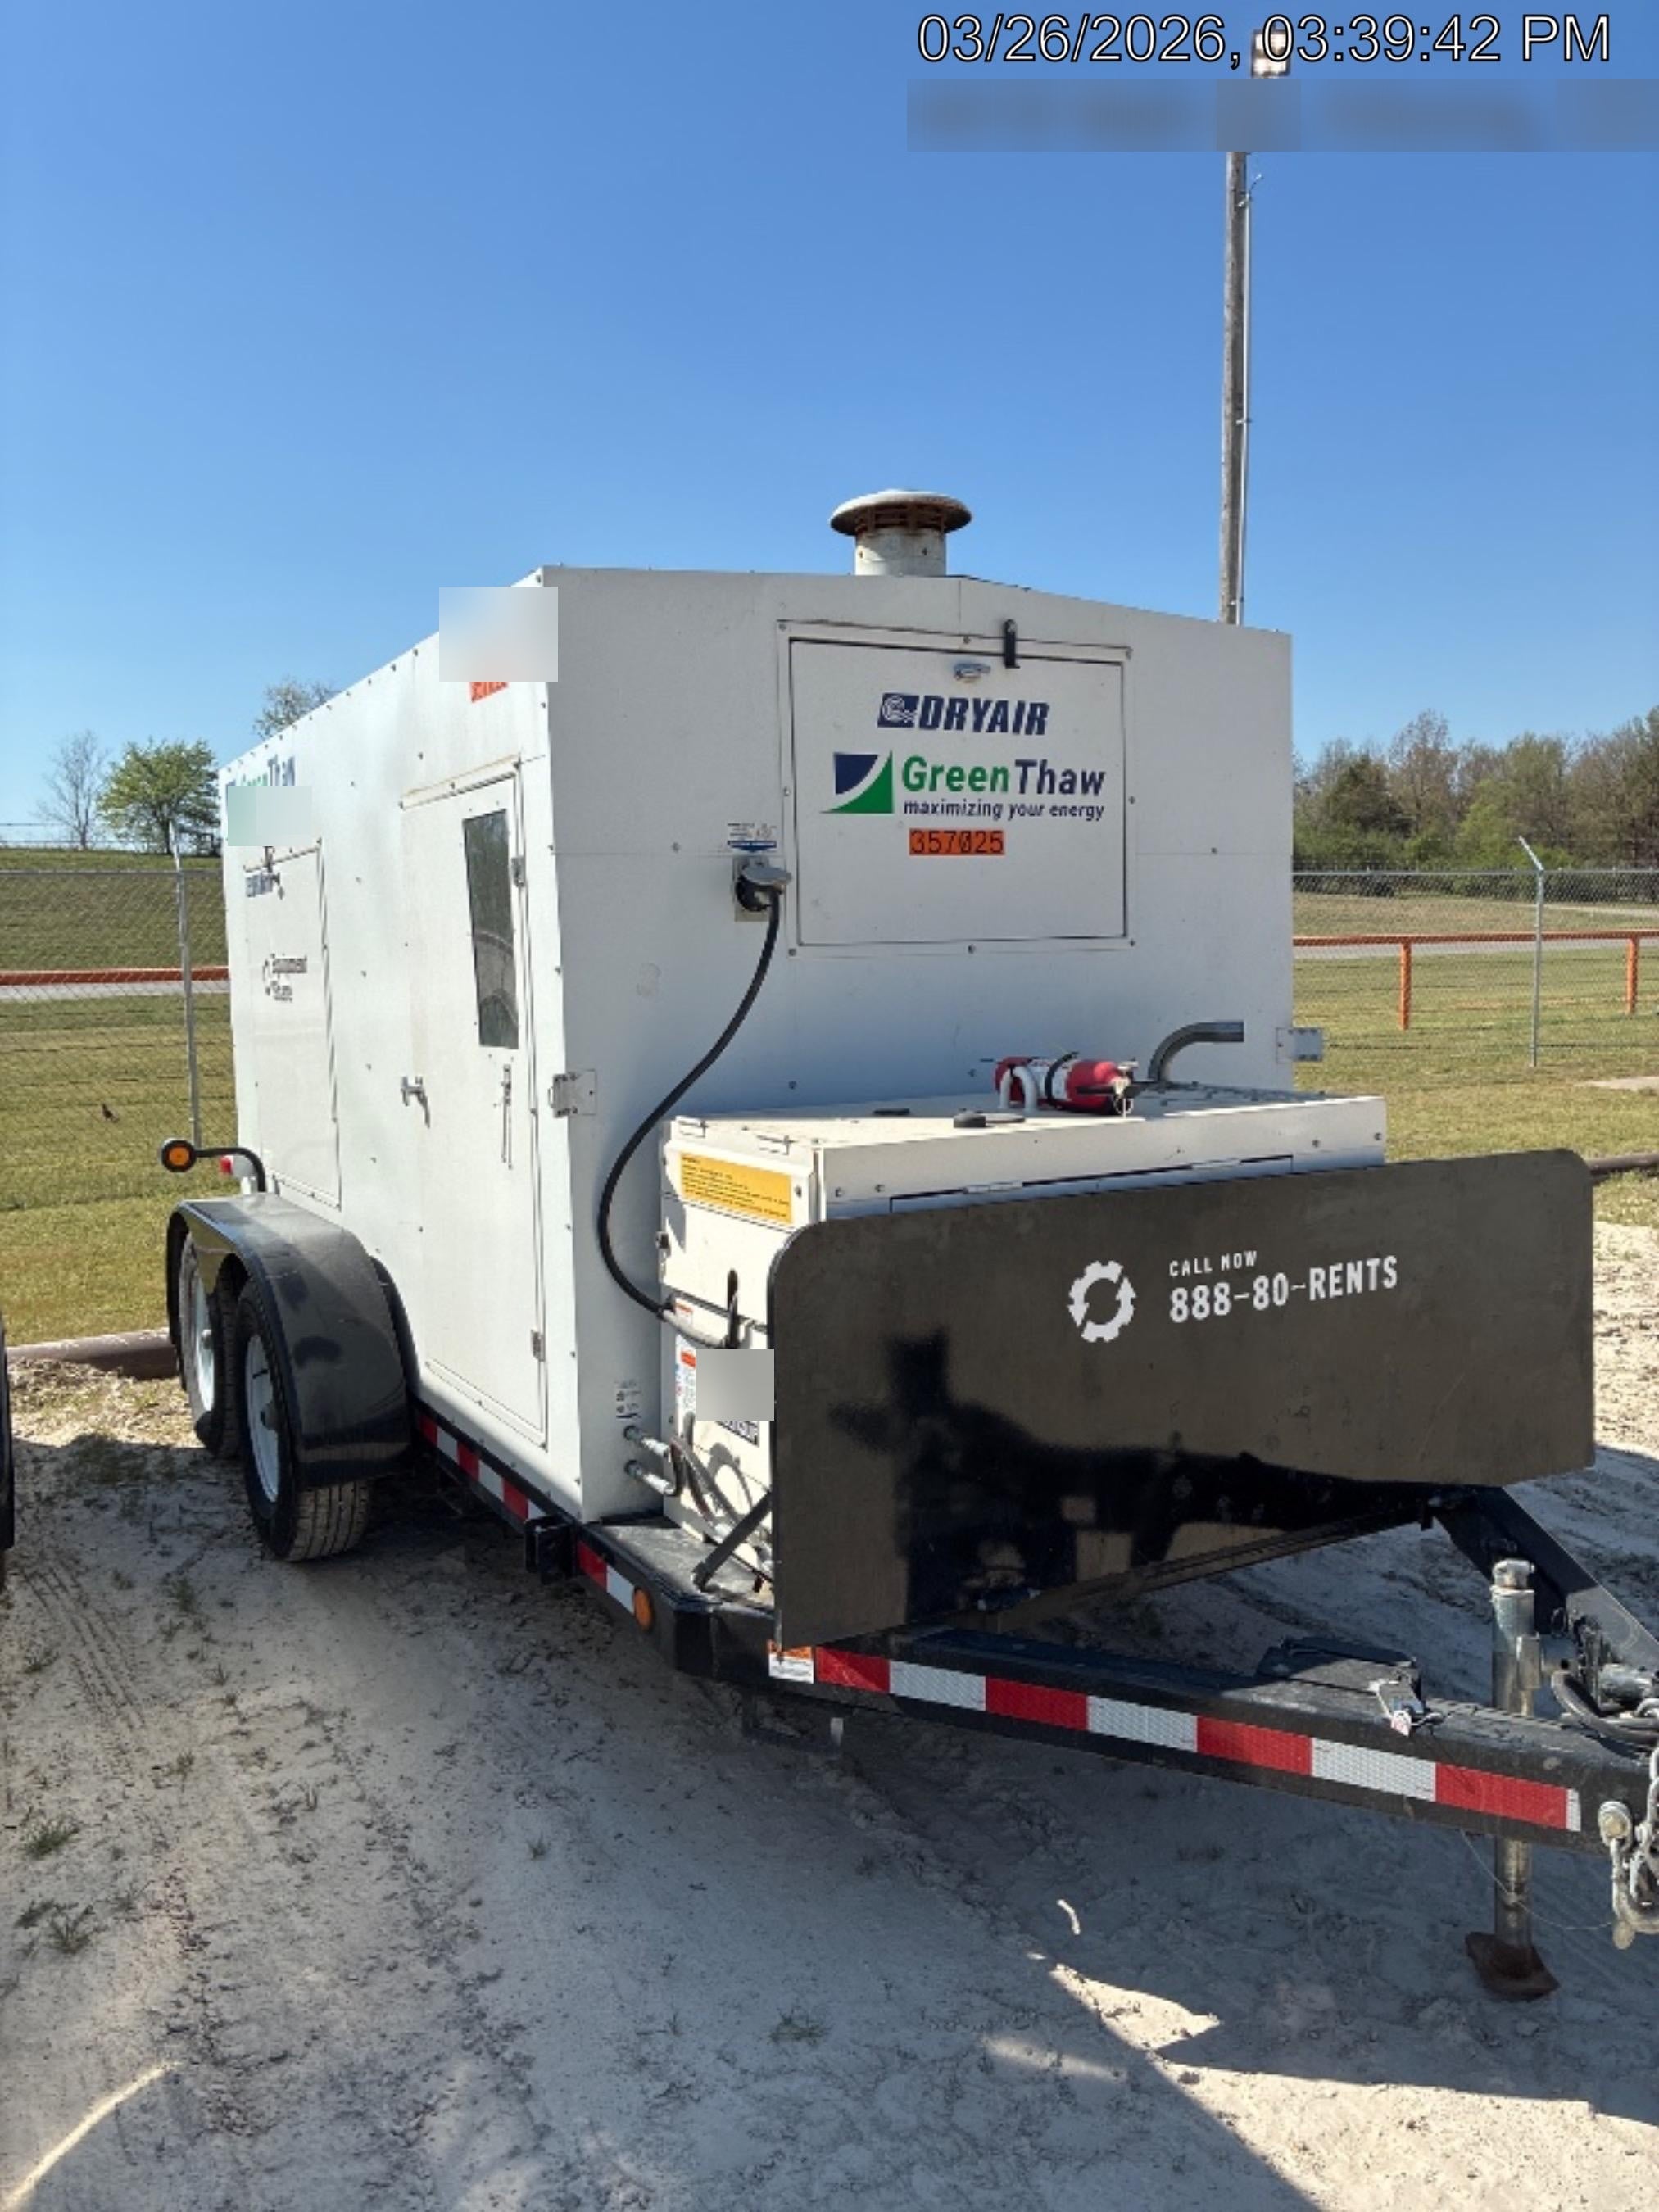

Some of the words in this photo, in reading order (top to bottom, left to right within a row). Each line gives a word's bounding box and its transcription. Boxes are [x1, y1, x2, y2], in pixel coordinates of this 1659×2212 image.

[919, 695, 1049, 736] DRYAIR
[904, 798, 1004, 822] maximizing
[1007, 803, 1045, 822] your
[1049, 804, 1105, 823] energy
[910, 830, 1004, 854] 357025
[1169, 1257, 1213, 1277] CALL
[1221, 1250, 1258, 1271] NOW
[1169, 1255, 1398, 1324] 888-80-RENTS
